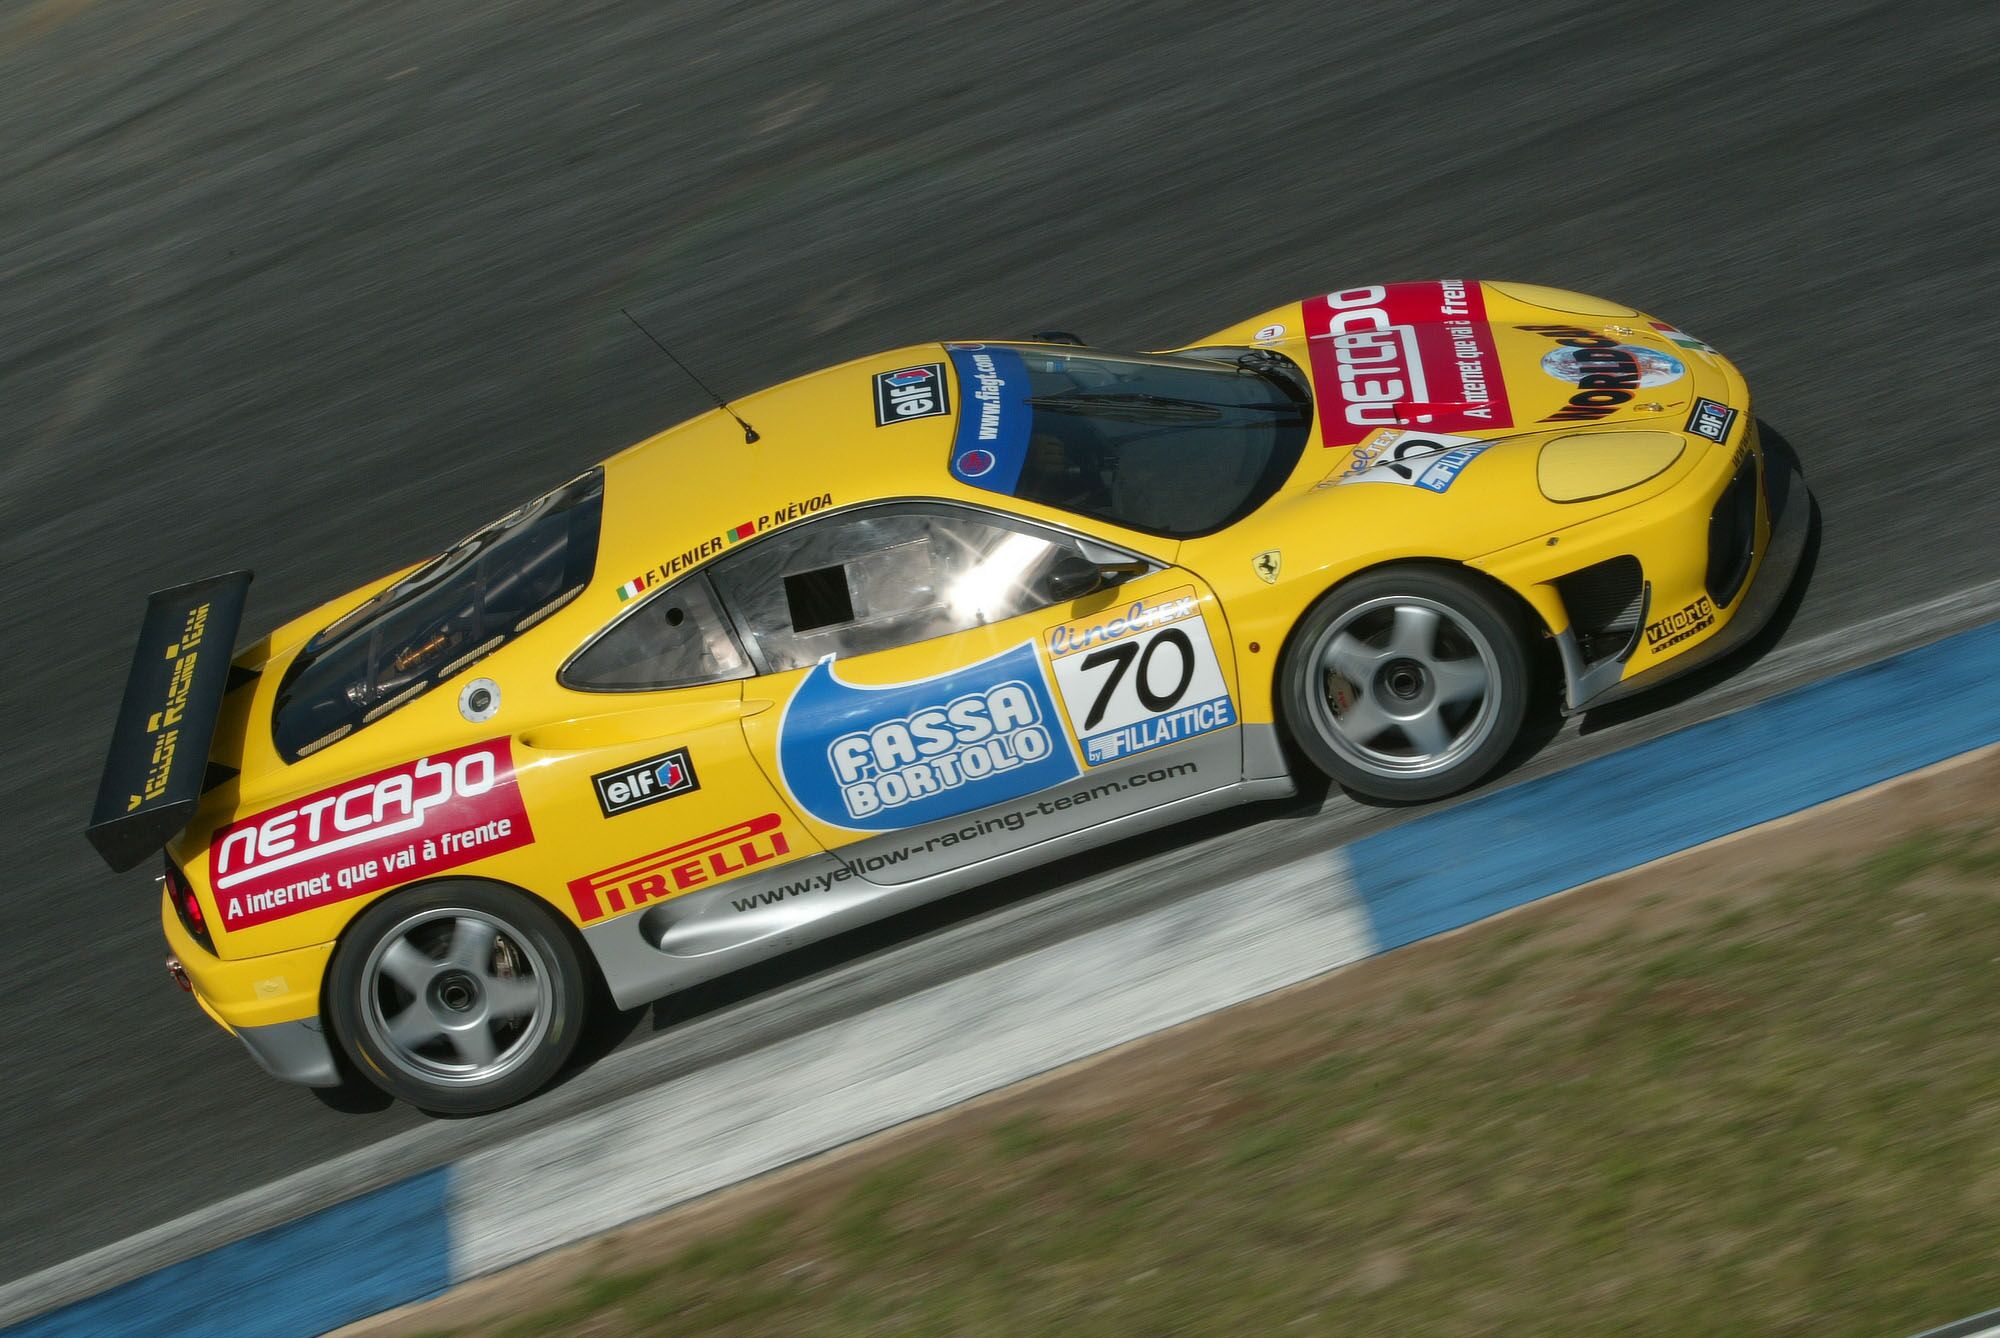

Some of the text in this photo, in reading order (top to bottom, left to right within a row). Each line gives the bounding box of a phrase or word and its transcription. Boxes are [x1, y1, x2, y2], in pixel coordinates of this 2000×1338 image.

[1445, 327, 1475, 340] vai
[1454, 341, 1484, 359] que
[890, 385, 934, 416] elf
[972, 354, 1005, 440] www.fiagt.com
[1454, 361, 1490, 403] nternet
[1534, 348, 1643, 424] WORLD
[1463, 407, 1492, 419] A
[1698, 413, 1723, 437] elf
[758, 516, 772, 532] P.
[646, 537, 723, 588] F. VENIER
[1080, 628, 1195, 731] 70
[831, 684, 1036, 785] FASSA
[1088, 699, 1229, 762] by FILLATTICE
[607, 770, 654, 804] elf
[844, 727, 1049, 818] BORTOLO
[731, 760, 1198, 912] www.yellow-racing-team.com
[228, 818, 512, 920] A internet que vai à frente
[567, 813, 790, 922] PIRELLI
